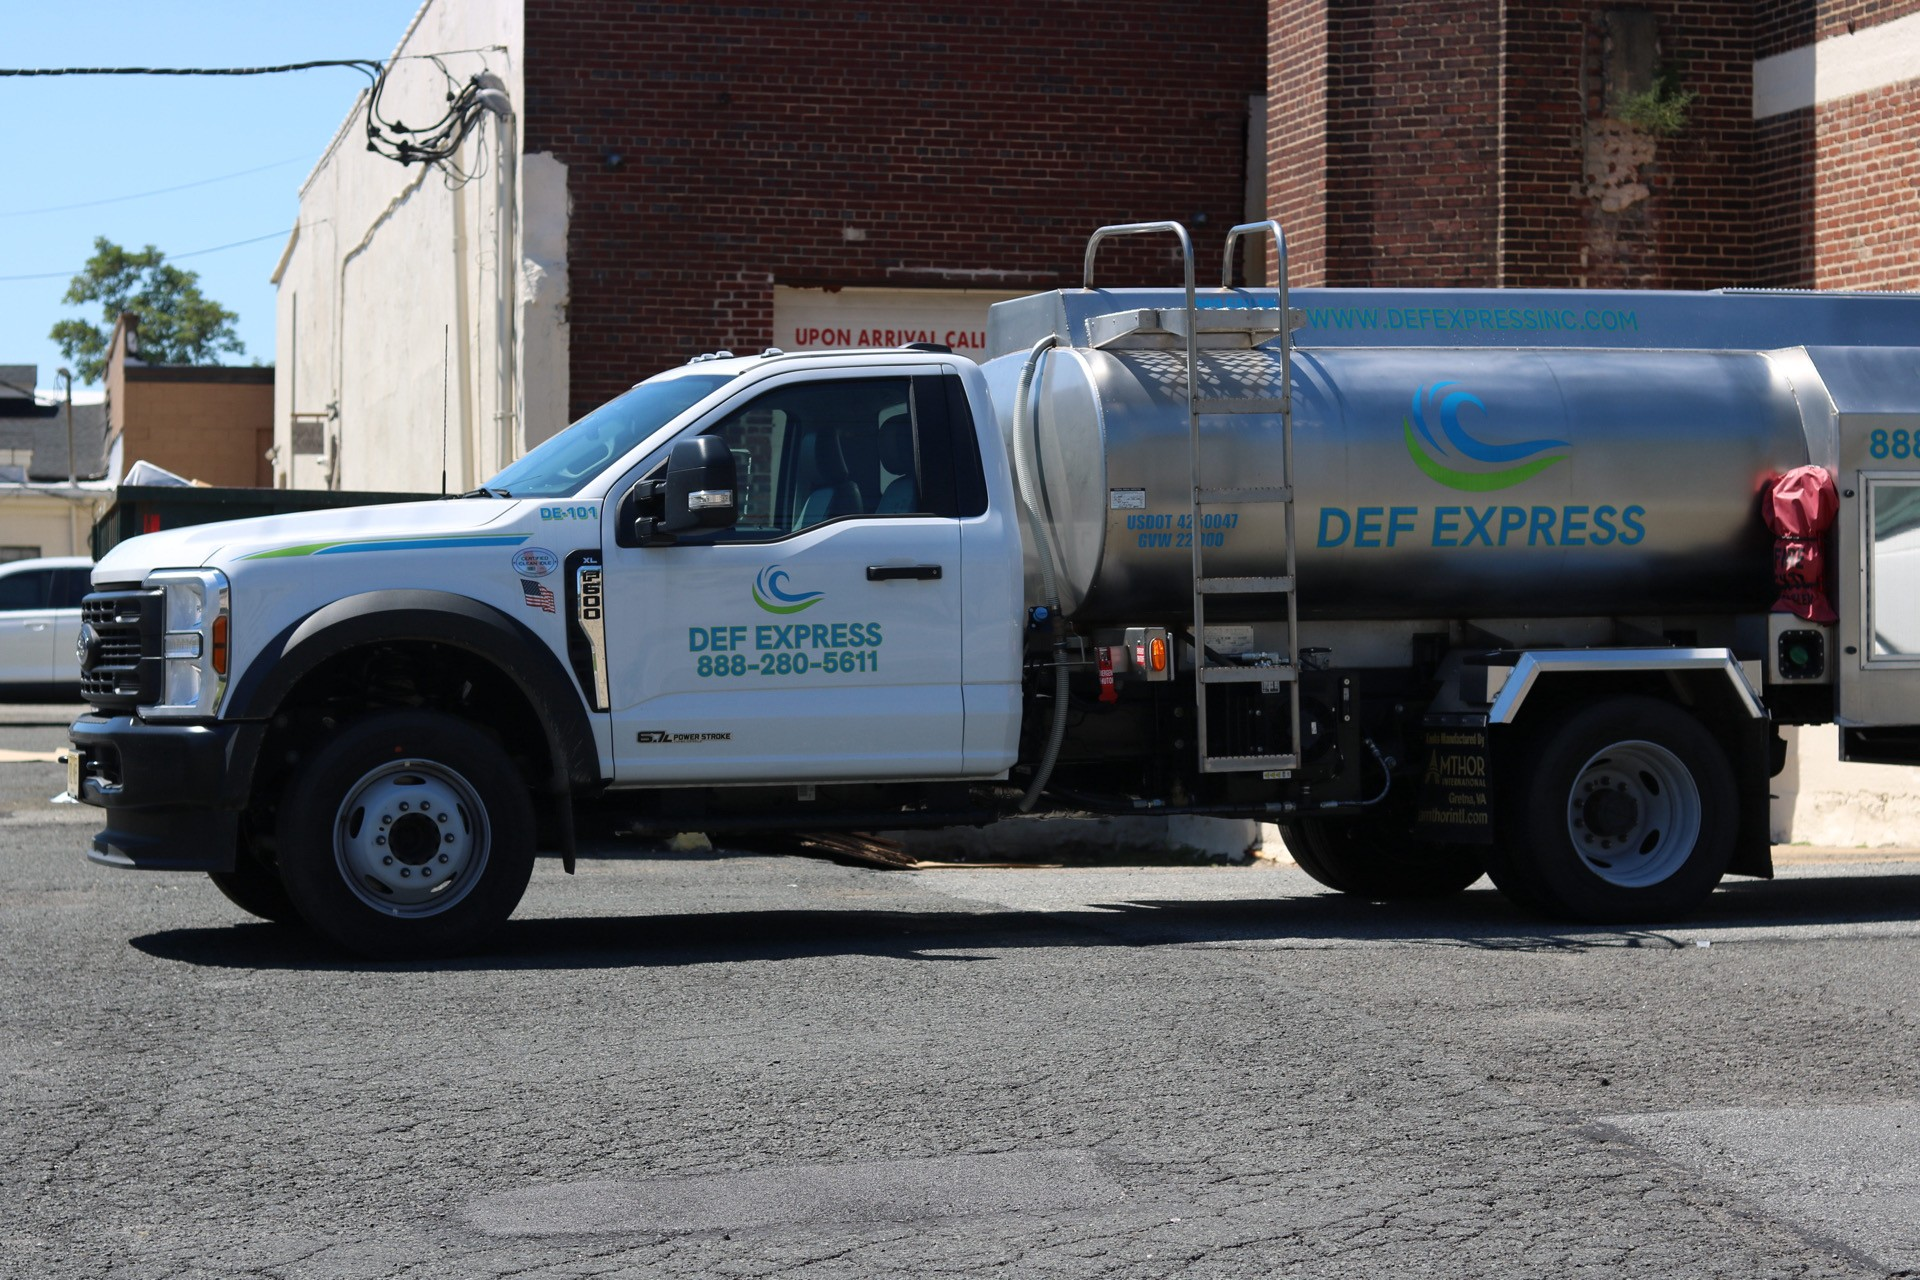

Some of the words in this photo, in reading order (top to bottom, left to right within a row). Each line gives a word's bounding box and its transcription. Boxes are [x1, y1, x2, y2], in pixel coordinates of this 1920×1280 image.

[1305, 307, 1638, 331] WWW.DEFEXPRESSINC.COM
[795, 328, 851, 346] UPON
[858, 329, 936, 347] ARRIVAL
[540, 506, 598, 520] DE-101
[1127, 514, 1173, 530] USDOT
[1177, 513, 1239, 529] 420047
[1316, 506, 1419, 549] DEF
[1431, 505, 1647, 547] EXPRESS
[1138, 533, 1173, 548] GVW
[582, 571, 601, 620] F600
[689, 626, 747, 652] DEF
[755, 622, 883, 650] EXPRESS
[697, 651, 878, 677] 888-280-5611
[1441, 777, 1486, 787] INTERNATIONAL
[1476, 793, 1487, 805] VA
